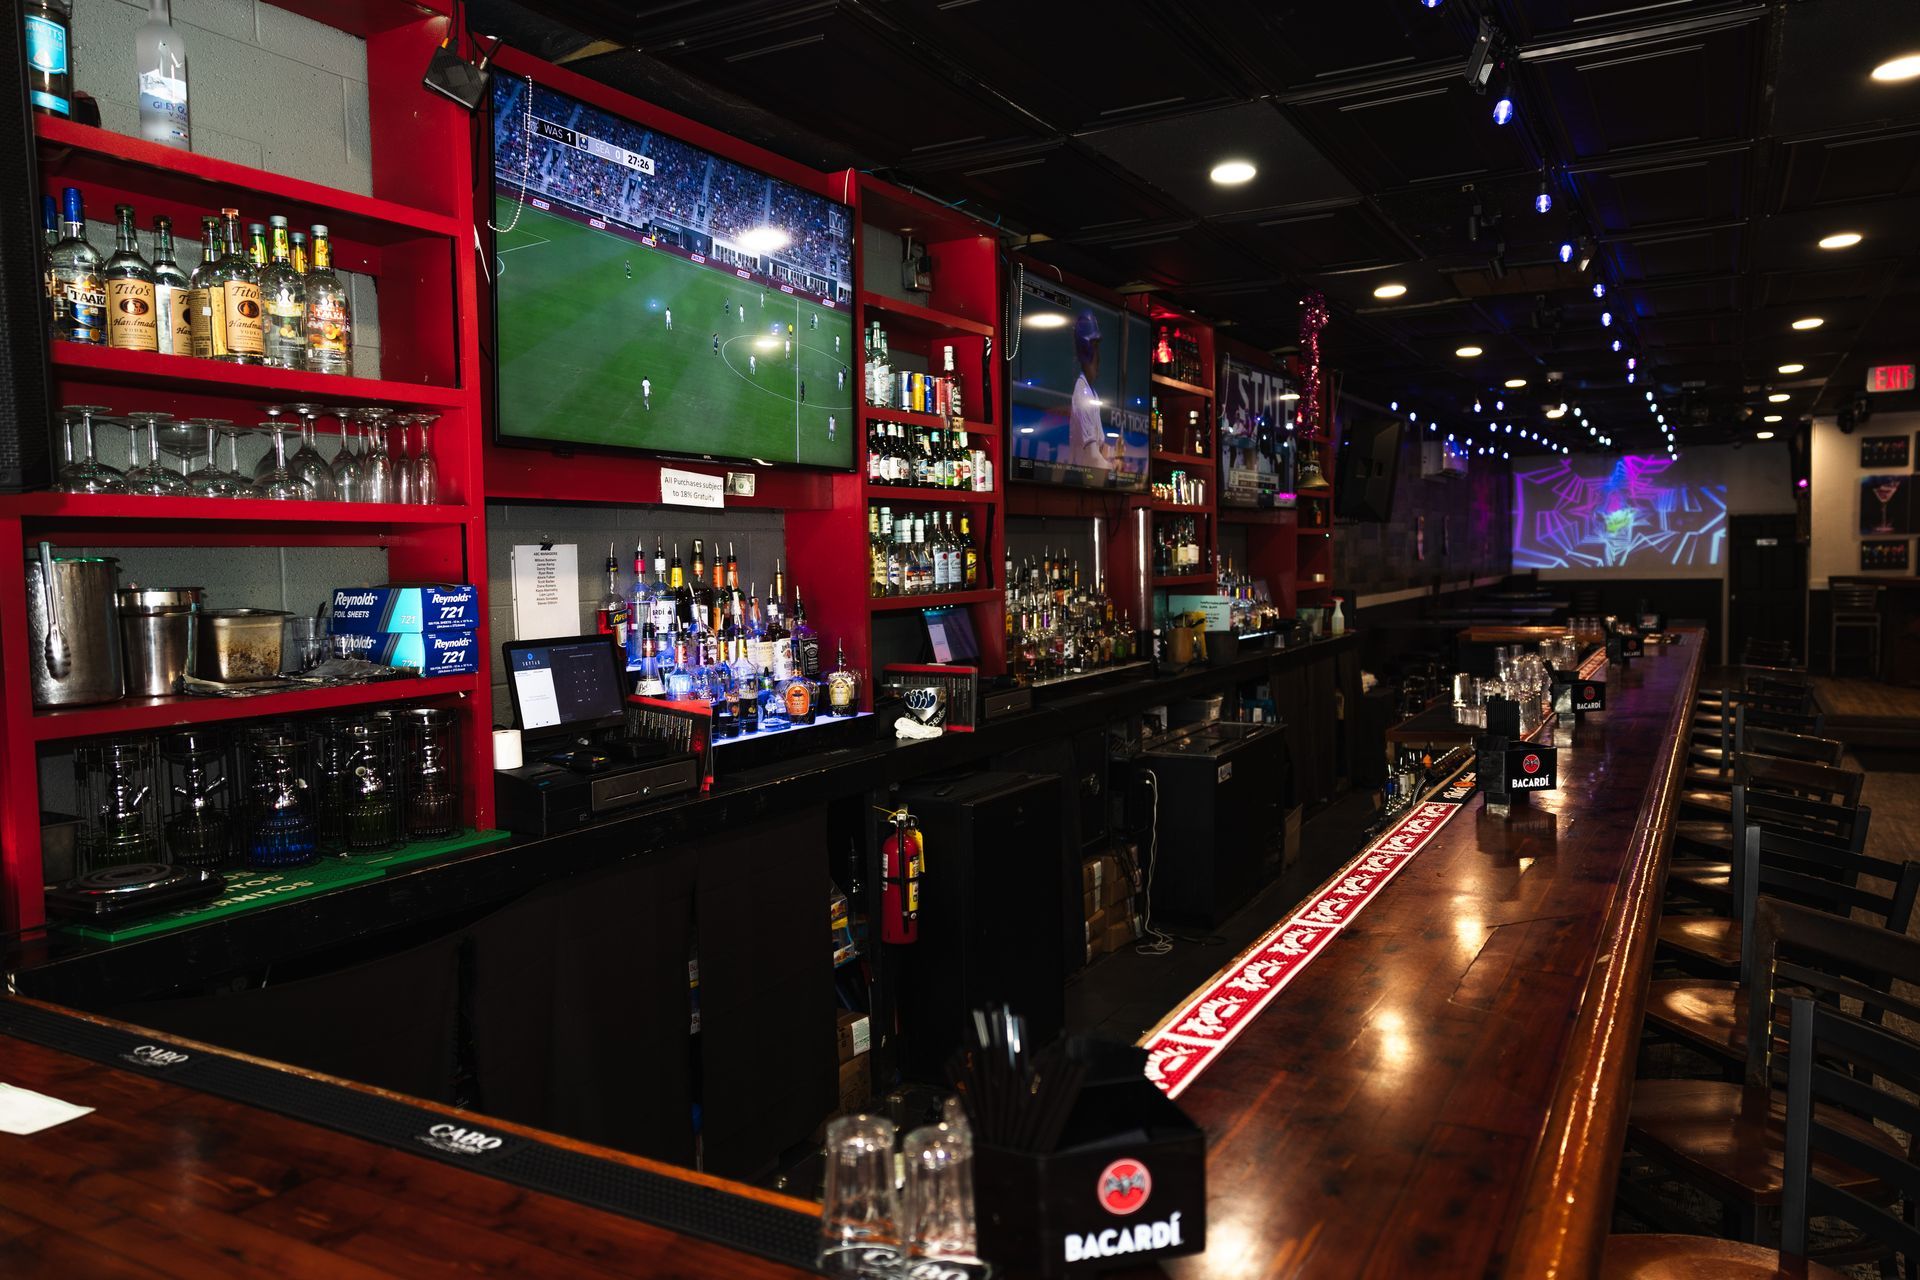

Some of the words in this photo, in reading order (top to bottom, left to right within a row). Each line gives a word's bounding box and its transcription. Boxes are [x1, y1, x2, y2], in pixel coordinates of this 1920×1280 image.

[543, 123, 563, 139] WAS
[566, 132, 572, 143] 1
[595, 142, 611, 156] SEA
[615, 150, 621, 160] 0
[627, 154, 650, 170] 27:26
[115, 283, 151, 296] Tito's
[113, 316, 156, 329] Handmade
[229, 319, 262, 331] Handma
[1875, 365, 1909, 391] EXIT
[1237, 370, 1297, 428] STATE
[664, 476, 673, 484] All
[673, 477, 702, 488] Purchases
[702, 482, 723, 491] subject
[680, 490, 693, 499] 18%
[693, 492, 715, 503] Gratuity
[334, 591, 375, 609] Reynolds
[431, 592, 469, 606] Reynolds
[334, 610, 346, 618] FOIL
[347, 610, 370, 618] SHEETS
[440, 605, 465, 619] 721
[400, 615, 417, 625] 721
[434, 637, 470, 651] Reynolds
[441, 650, 466, 664] 721
[1576, 700, 1601, 710] BACARDÍ
[1511, 774, 1550, 789] BACARDÍ
[133, 1045, 190, 1064] CABO
[429, 1123, 503, 1150] CABO
[1064, 1209, 1183, 1263] BACARDÍ
